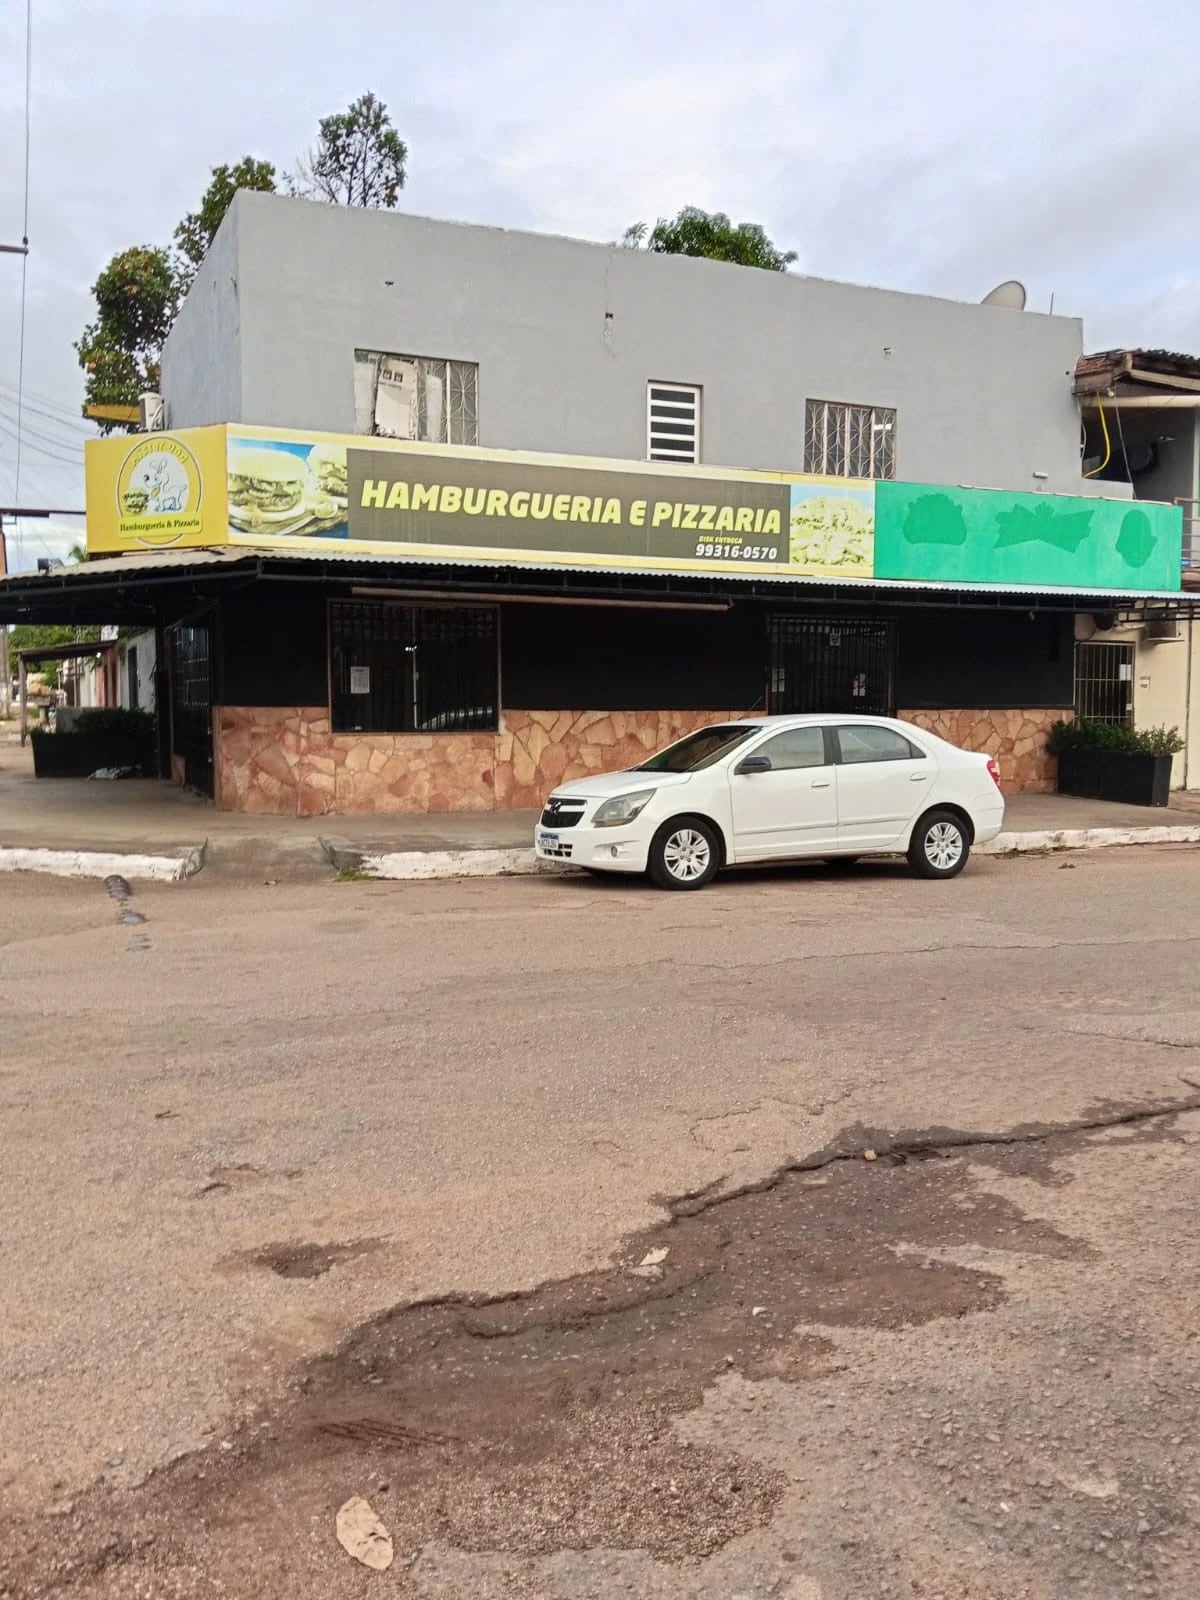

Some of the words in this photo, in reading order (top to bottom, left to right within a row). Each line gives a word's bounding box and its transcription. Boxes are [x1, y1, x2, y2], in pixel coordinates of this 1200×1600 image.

[361, 479, 622, 525] HAMBURGUERIA
[629, 500, 648, 526] E
[652, 502, 781, 534] PIZZARIA
[120, 521, 165, 532] Hamburgueria
[174, 519, 200, 528] Pizzaria
[715, 536, 742, 544] ENTREGA
[695, 543, 778, 560] 99316-0570
